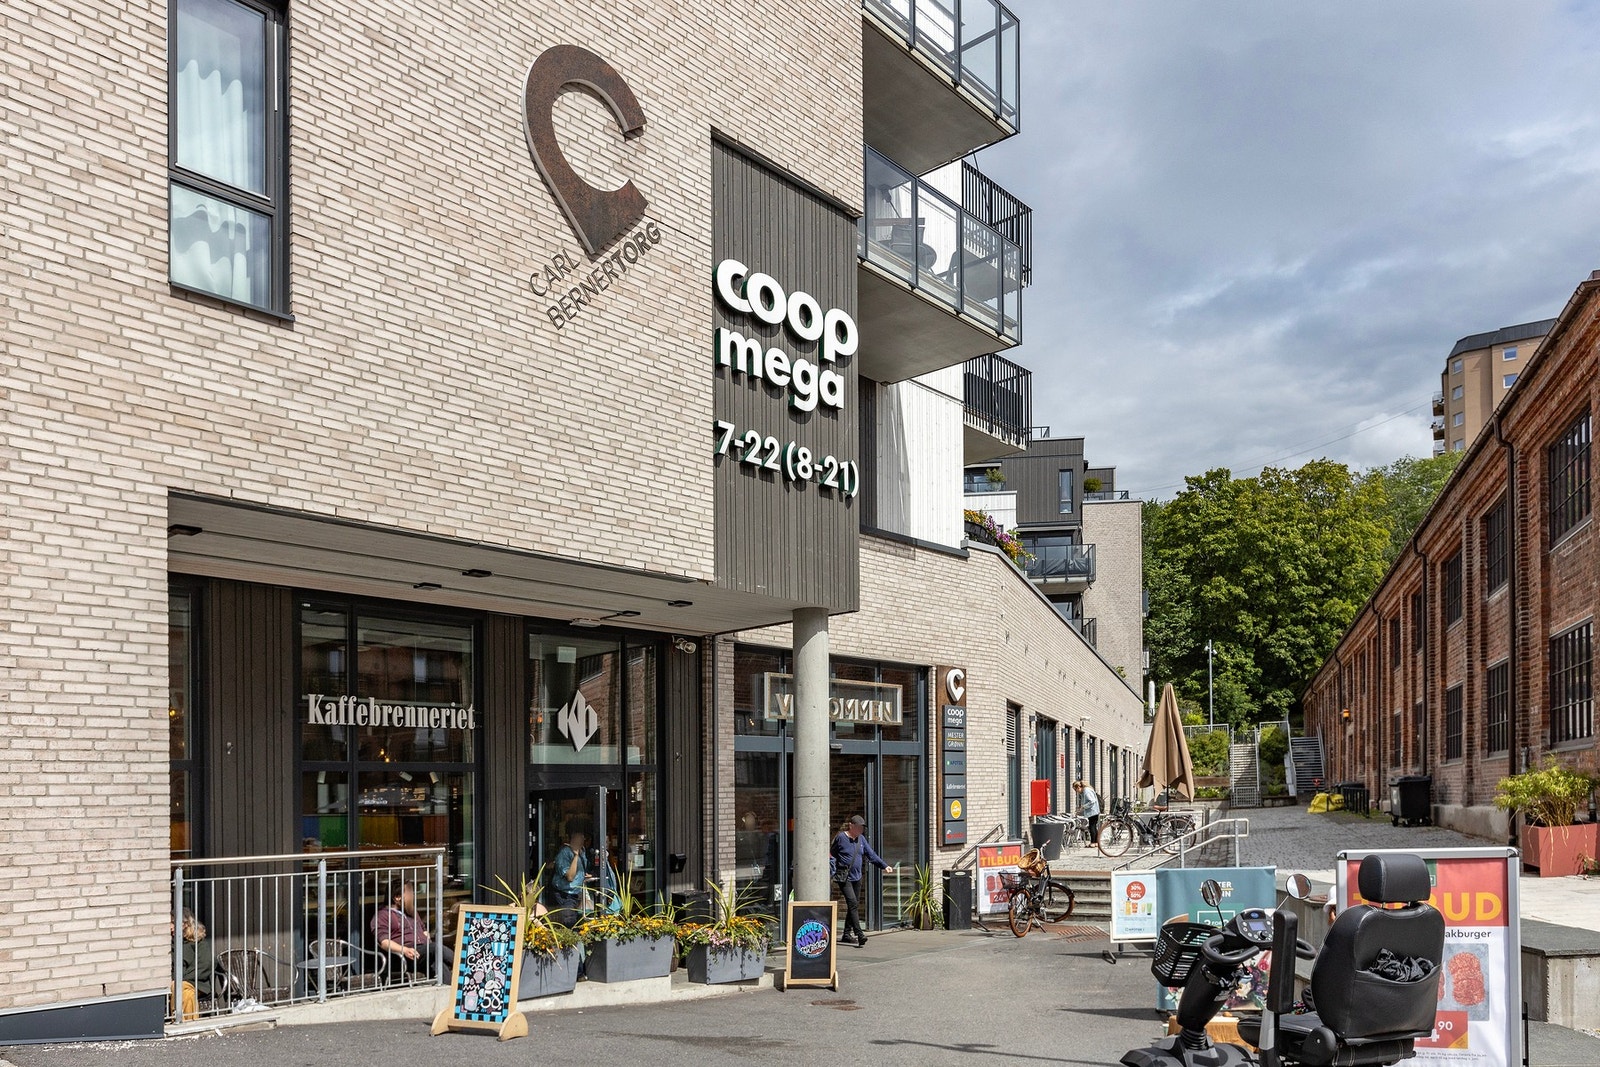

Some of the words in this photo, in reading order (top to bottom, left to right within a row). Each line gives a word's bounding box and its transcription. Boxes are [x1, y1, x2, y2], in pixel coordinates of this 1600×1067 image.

[529, 249, 580, 297] CARL
[546, 222, 661, 330] BERNERTORG
[713, 258, 859, 363] coop
[715, 327, 845, 412] mega
[714, 419, 781, 473] 7-22
[782, 440, 859, 498] (8-21)
[307, 693, 476, 730] Kaffebrenneriet
[775, 692, 893, 723] VOMMEN
[947, 708, 964, 717] coop
[981, 854, 1019, 867] TILBUD
[1445, 929, 1492, 939] akburger
[1437, 1020, 1453, 1031] 90
